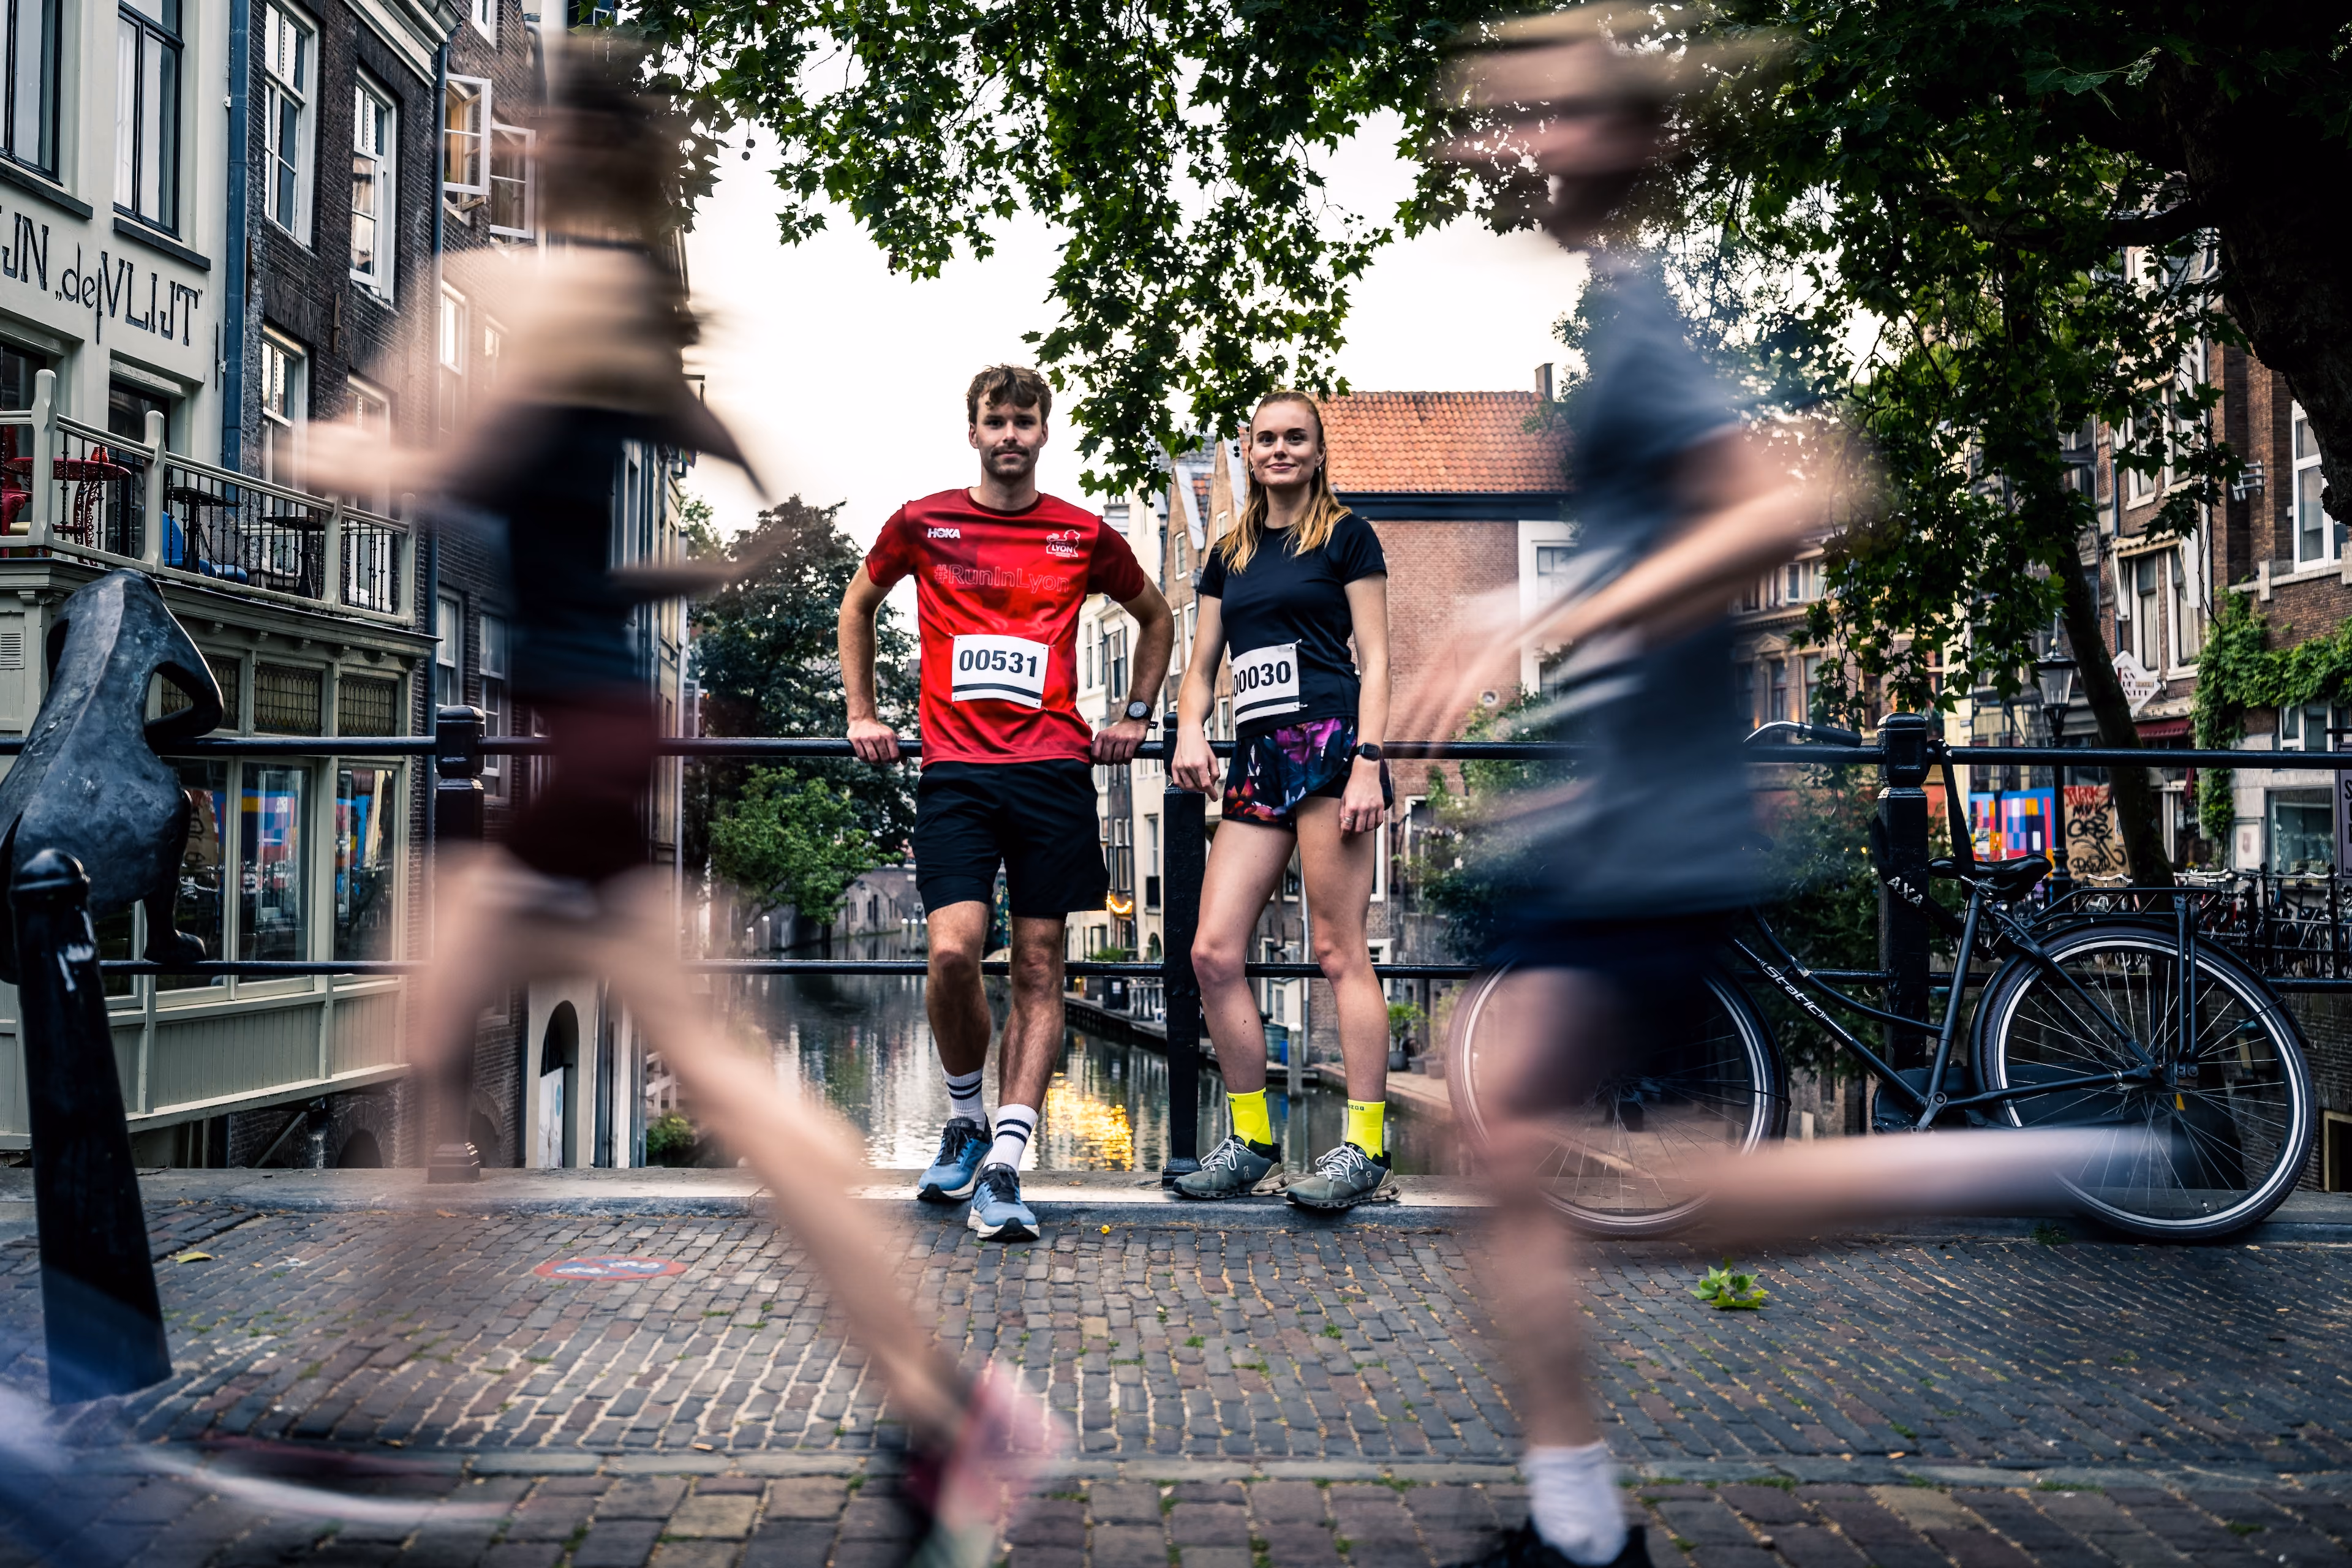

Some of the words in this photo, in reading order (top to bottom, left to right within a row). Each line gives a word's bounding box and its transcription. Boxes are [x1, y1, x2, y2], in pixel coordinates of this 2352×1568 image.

[927, 527, 961, 539] HOKA
[1052, 544, 1072, 553] LYON
[934, 564, 1069, 594] #RunInLyon
[959, 649, 1037, 677] 00531
[1234, 661, 1291, 697] 00030
[1763, 966, 1822, 1016] Static
